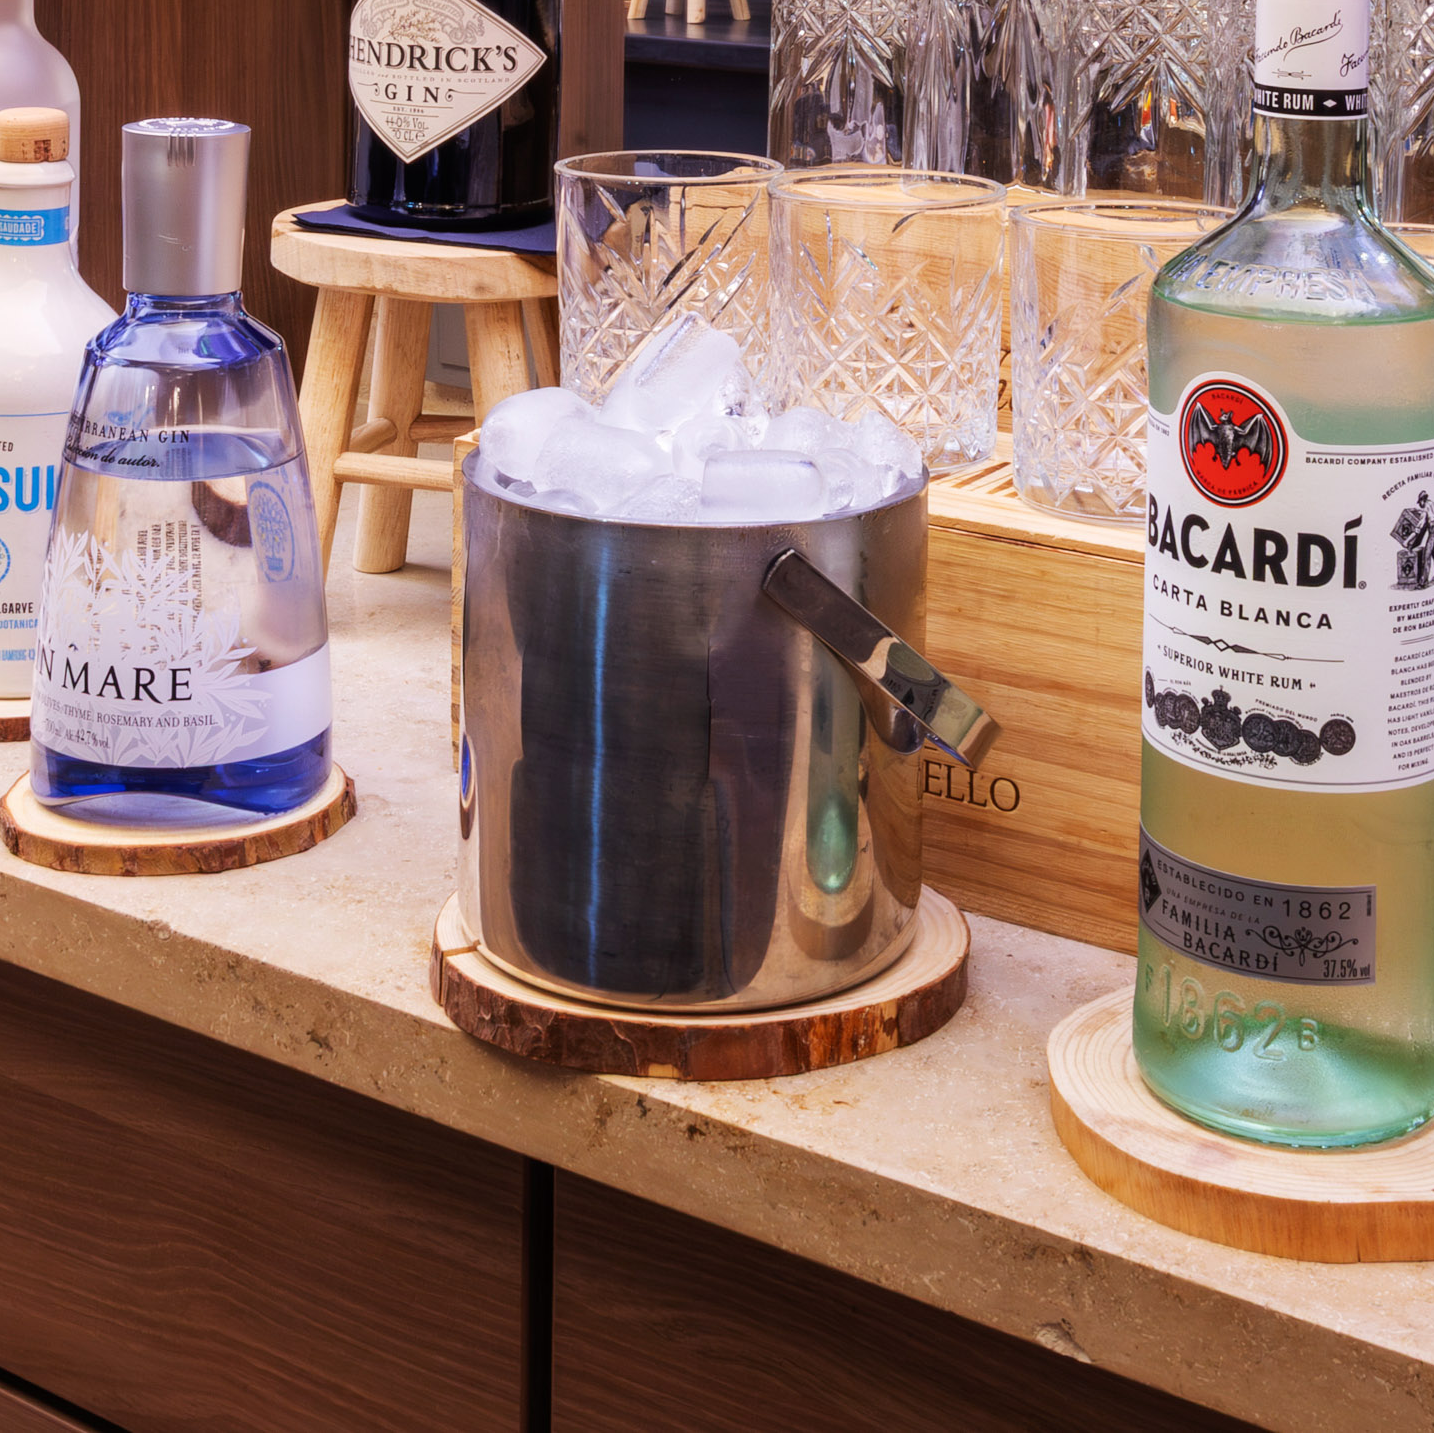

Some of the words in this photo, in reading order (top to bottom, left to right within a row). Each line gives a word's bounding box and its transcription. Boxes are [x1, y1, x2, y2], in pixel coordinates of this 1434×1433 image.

[384, 83, 441, 104] GIN
[1283, 93, 1314, 111] RUM
[0, 222, 37, 235] SAUDADE
[1196, 260, 1378, 302] EMPRESA
[158, 429, 190, 444] GIN
[101, 449, 115, 463] de
[117, 454, 161, 468] autor.
[1305, 456, 1345, 465] BACARDÍ
[1347, 457, 1388, 466] COMPANY
[1389, 453, 1434, 465] ESTABLISHED
[1381, 480, 1406, 502] RECETA
[1407, 471, 1432, 484] FAMILIAR
[1147, 492, 1364, 590] BACARDÍ
[1152, 574, 1208, 612] CARTA
[1219, 599, 1333, 630] BLANCA
[1388, 602, 1420, 613] EXPERTLY
[1396, 615, 1406, 623] BY
[1392, 626, 1402, 634] DE
[1403, 623, 1417, 632] RON
[1394, 651, 1421, 663] BACARDÍ
[1162, 645, 1214, 675] SUPERIOR
[1218, 665, 1264, 686] WHITE
[1270, 676, 1303, 691] RUM
[1390, 665, 1416, 676] BLANCA
[61, 655, 194, 705] MARE
[1400, 676, 1425, 686] BLENDED
[1390, 689, 1421, 699] MAESTROS
[1255, 698, 1284, 714] PREMIADO
[96, 711, 153, 728] ROSEMARY
[155, 715, 180, 728] AND
[183, 714, 219, 728] BASIL.
[1392, 751, 1407, 760] AND
[1414, 744, 1434, 756] PERFECT
[1399, 738, 1412, 748] OAK
[923, 759, 1021, 812] ELLO
[1156, 858, 1246, 903] ESTABLECIDO
[1252, 893, 1275, 909] EN
[1281, 899, 1352, 921] 1862
[1166, 886, 1183, 900] UNA
[1183, 895, 1227, 917] EMPRESA
[1229, 910, 1244, 922] DE
[1247, 915, 1261, 925] LA
[1160, 898, 1237, 944] FAMILIA
[1182, 930, 1279, 973] BACARDÍ
[1322, 958, 1358, 978] 37.5%
[1359, 962, 1371, 978] vol
